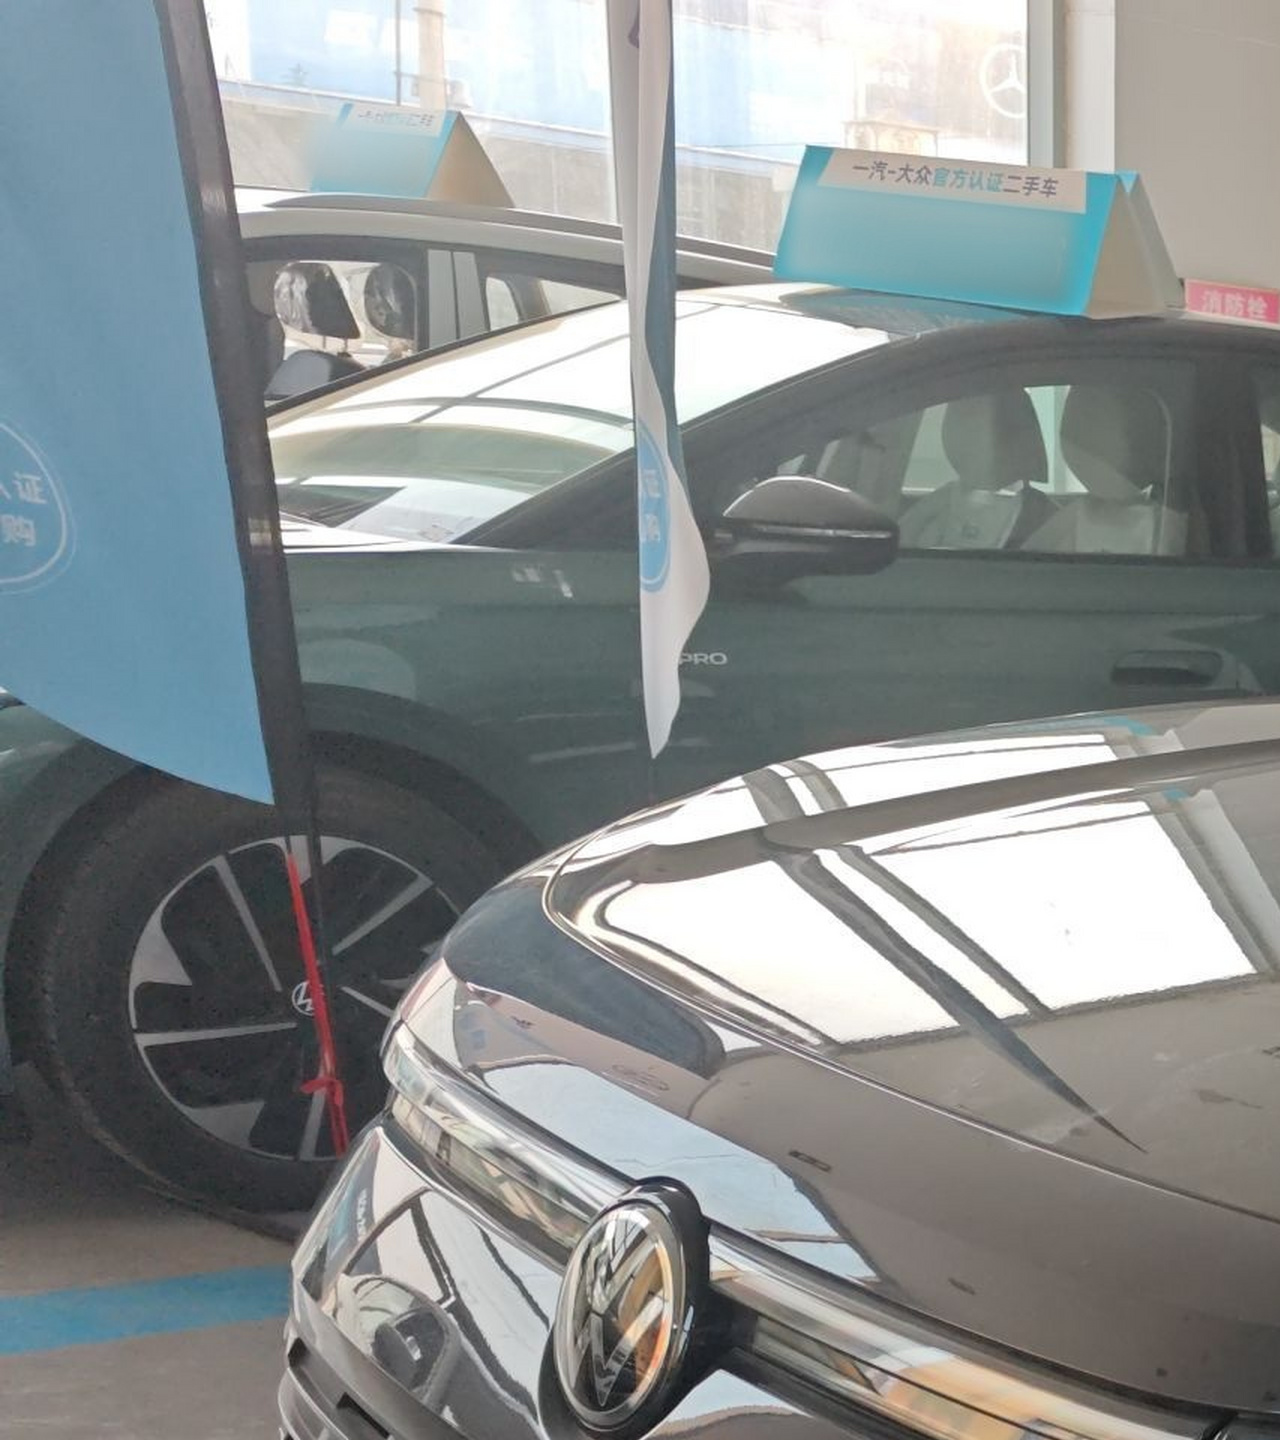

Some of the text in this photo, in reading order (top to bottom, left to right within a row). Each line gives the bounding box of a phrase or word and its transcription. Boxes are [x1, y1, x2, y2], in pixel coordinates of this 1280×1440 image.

[852, 160, 1058, 199] 一汽-大众官方认证二手车
[0, 471, 48, 504] 证
[679, 652, 728, 666] PRO
